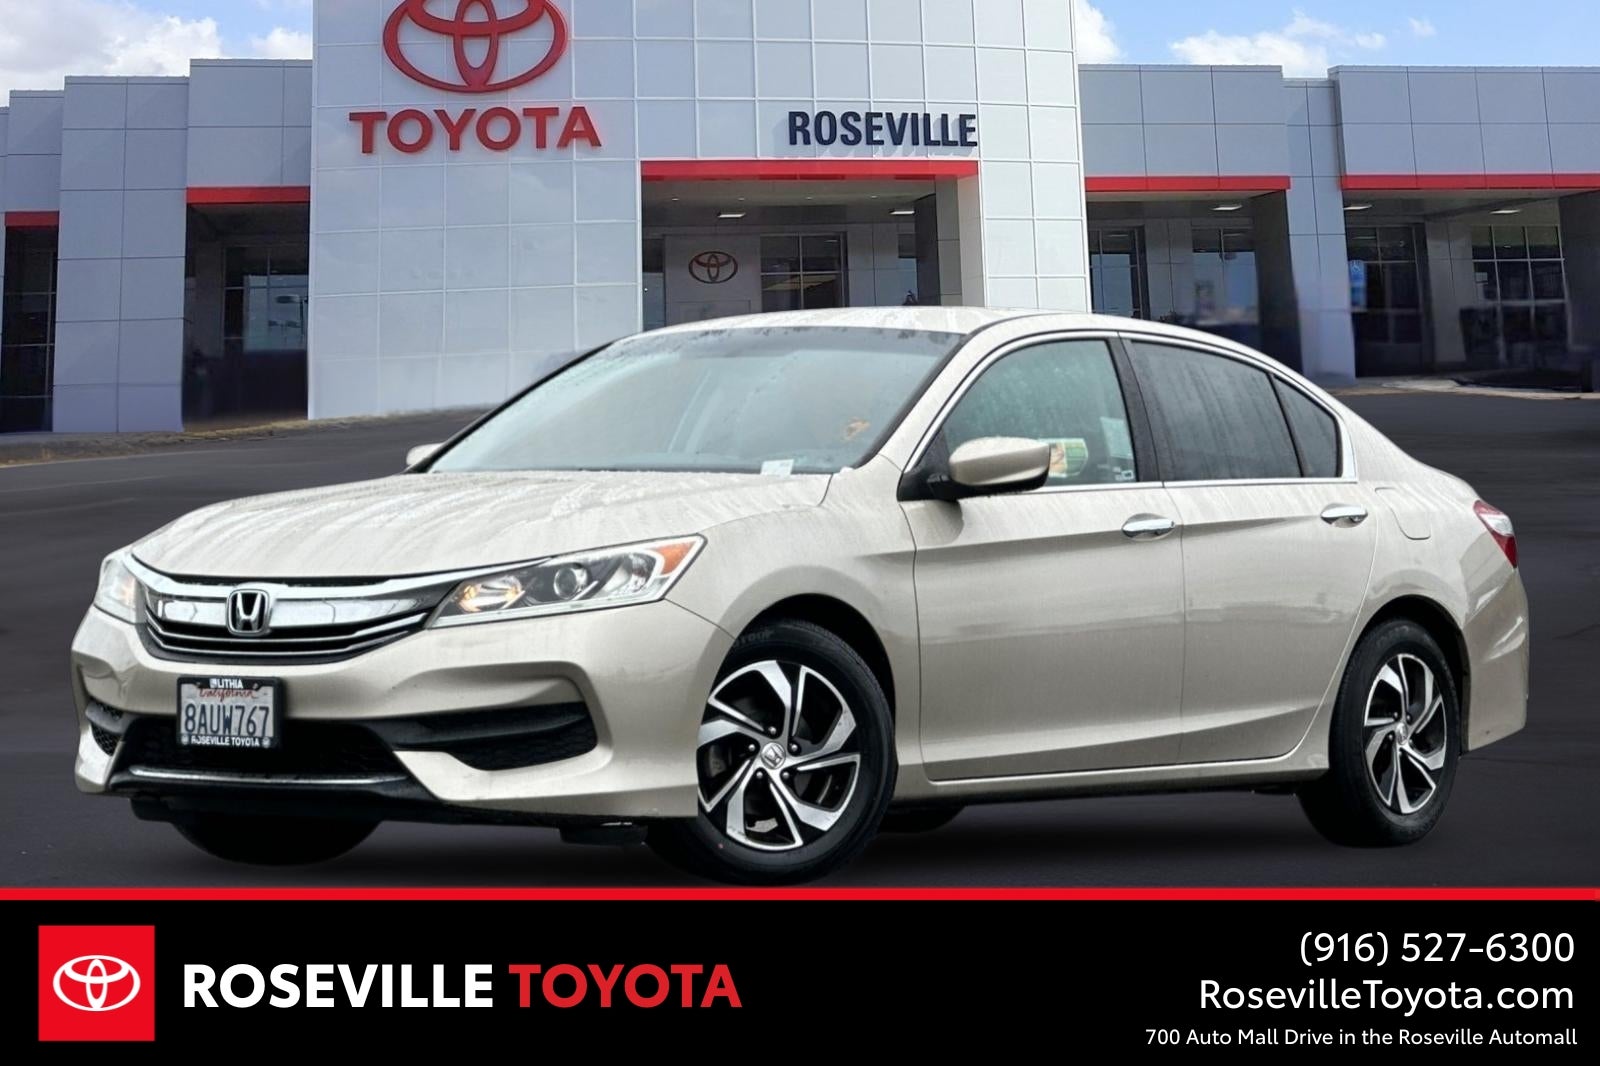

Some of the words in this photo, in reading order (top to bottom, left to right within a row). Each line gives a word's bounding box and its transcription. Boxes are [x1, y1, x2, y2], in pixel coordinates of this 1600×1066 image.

[349, 106, 602, 154] TOYOTA
[788, 110, 978, 147] ROSEVILLE
[217, 678, 244, 689] LITHIA
[185, 703, 270, 738] 8AUW767
